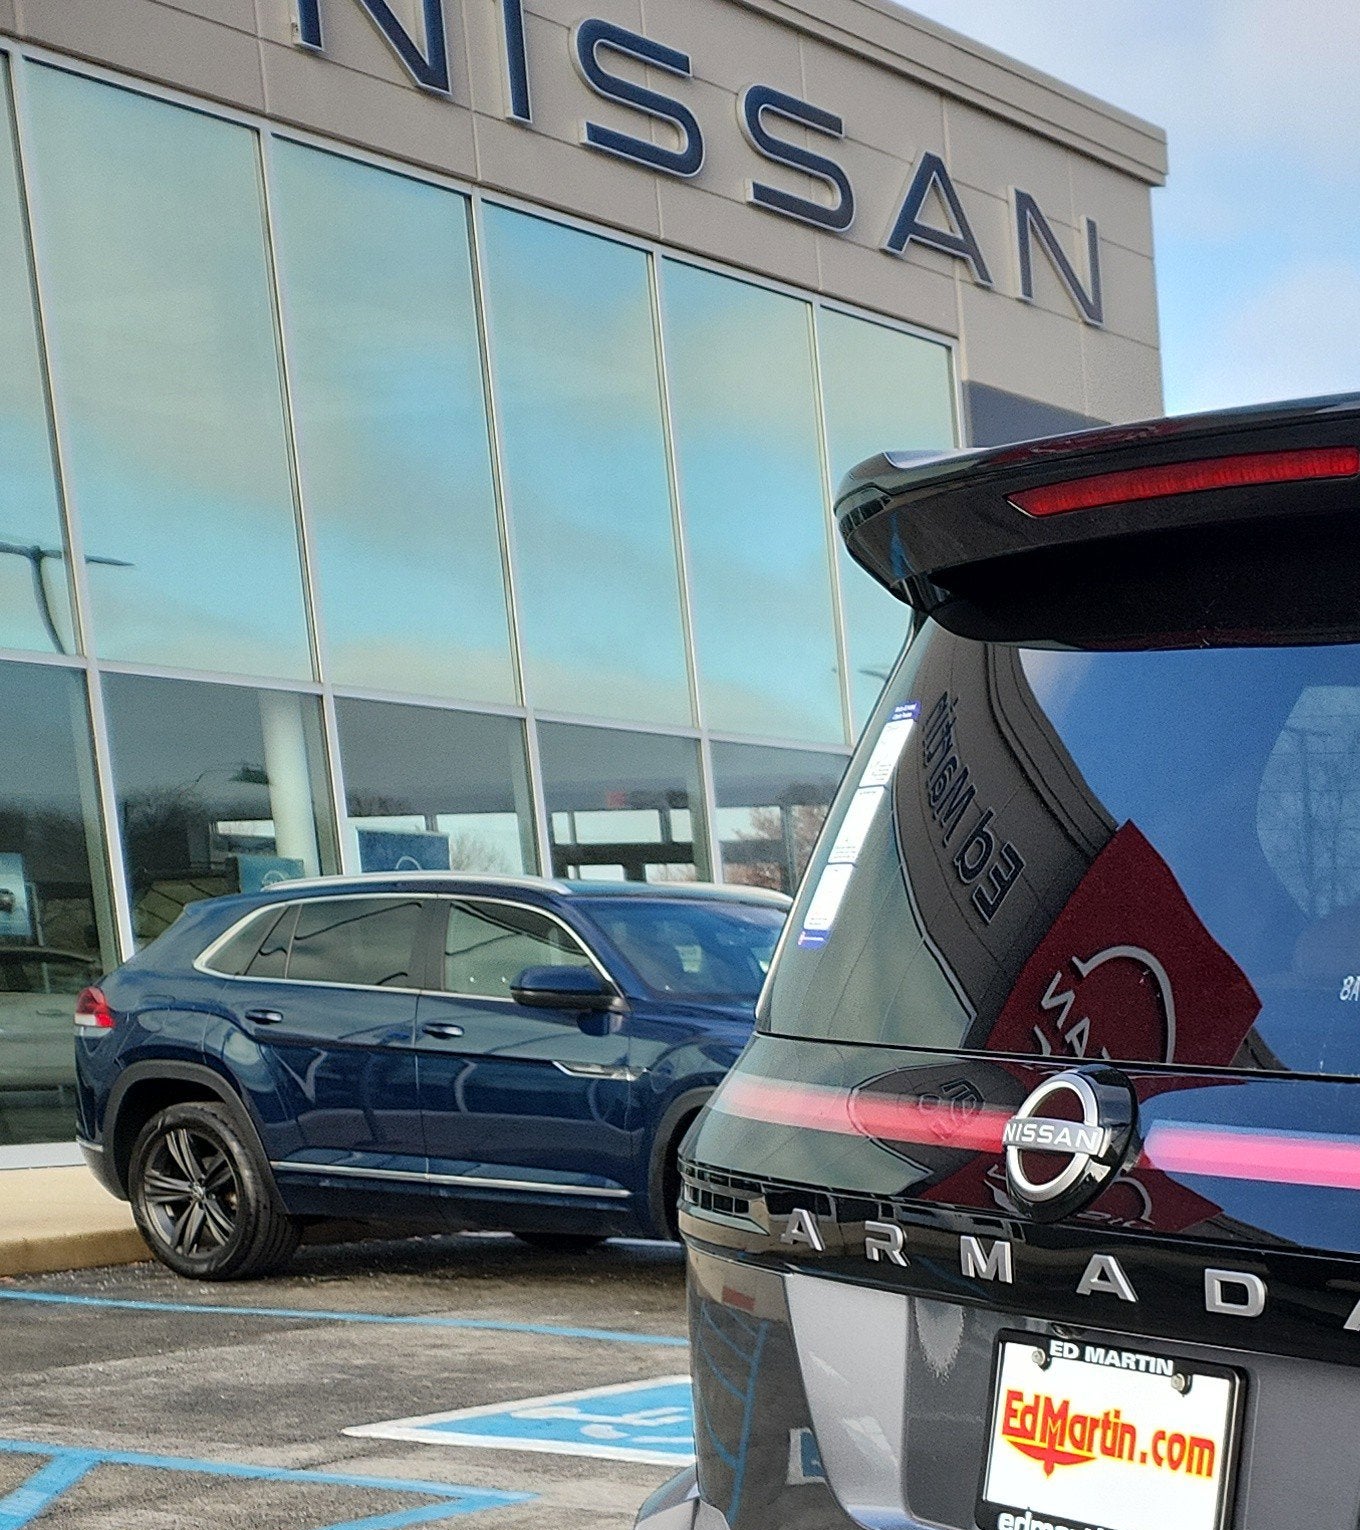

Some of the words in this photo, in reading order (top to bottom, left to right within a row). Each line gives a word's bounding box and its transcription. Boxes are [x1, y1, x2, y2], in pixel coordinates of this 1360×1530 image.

[1002, 1122, 1099, 1151] NISSAN
[1049, 1339, 1080, 1360] ED
[1084, 1345, 1174, 1377] MARTIN
